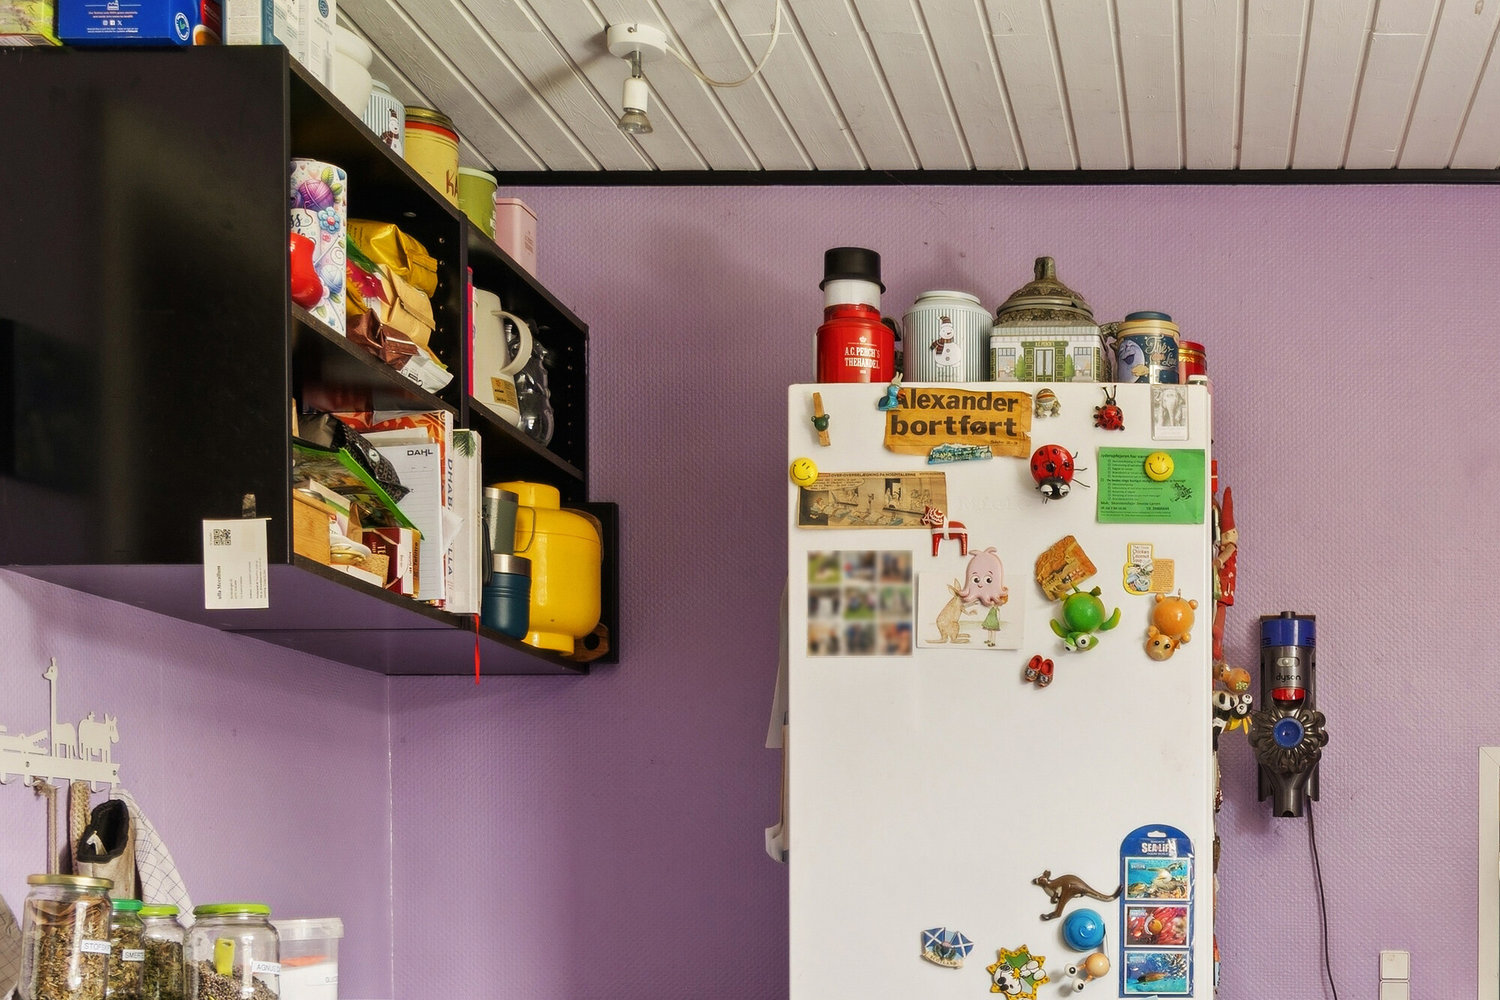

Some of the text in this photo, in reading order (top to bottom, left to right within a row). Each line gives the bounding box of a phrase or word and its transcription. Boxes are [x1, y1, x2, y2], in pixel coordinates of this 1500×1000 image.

[897, 388, 1018, 412] Alexander
[891, 415, 1017, 436] bortført
[406, 449, 433, 457] DAHL
[1276, 673, 1301, 682] dyson
[1141, 842, 1157, 853] SEA
